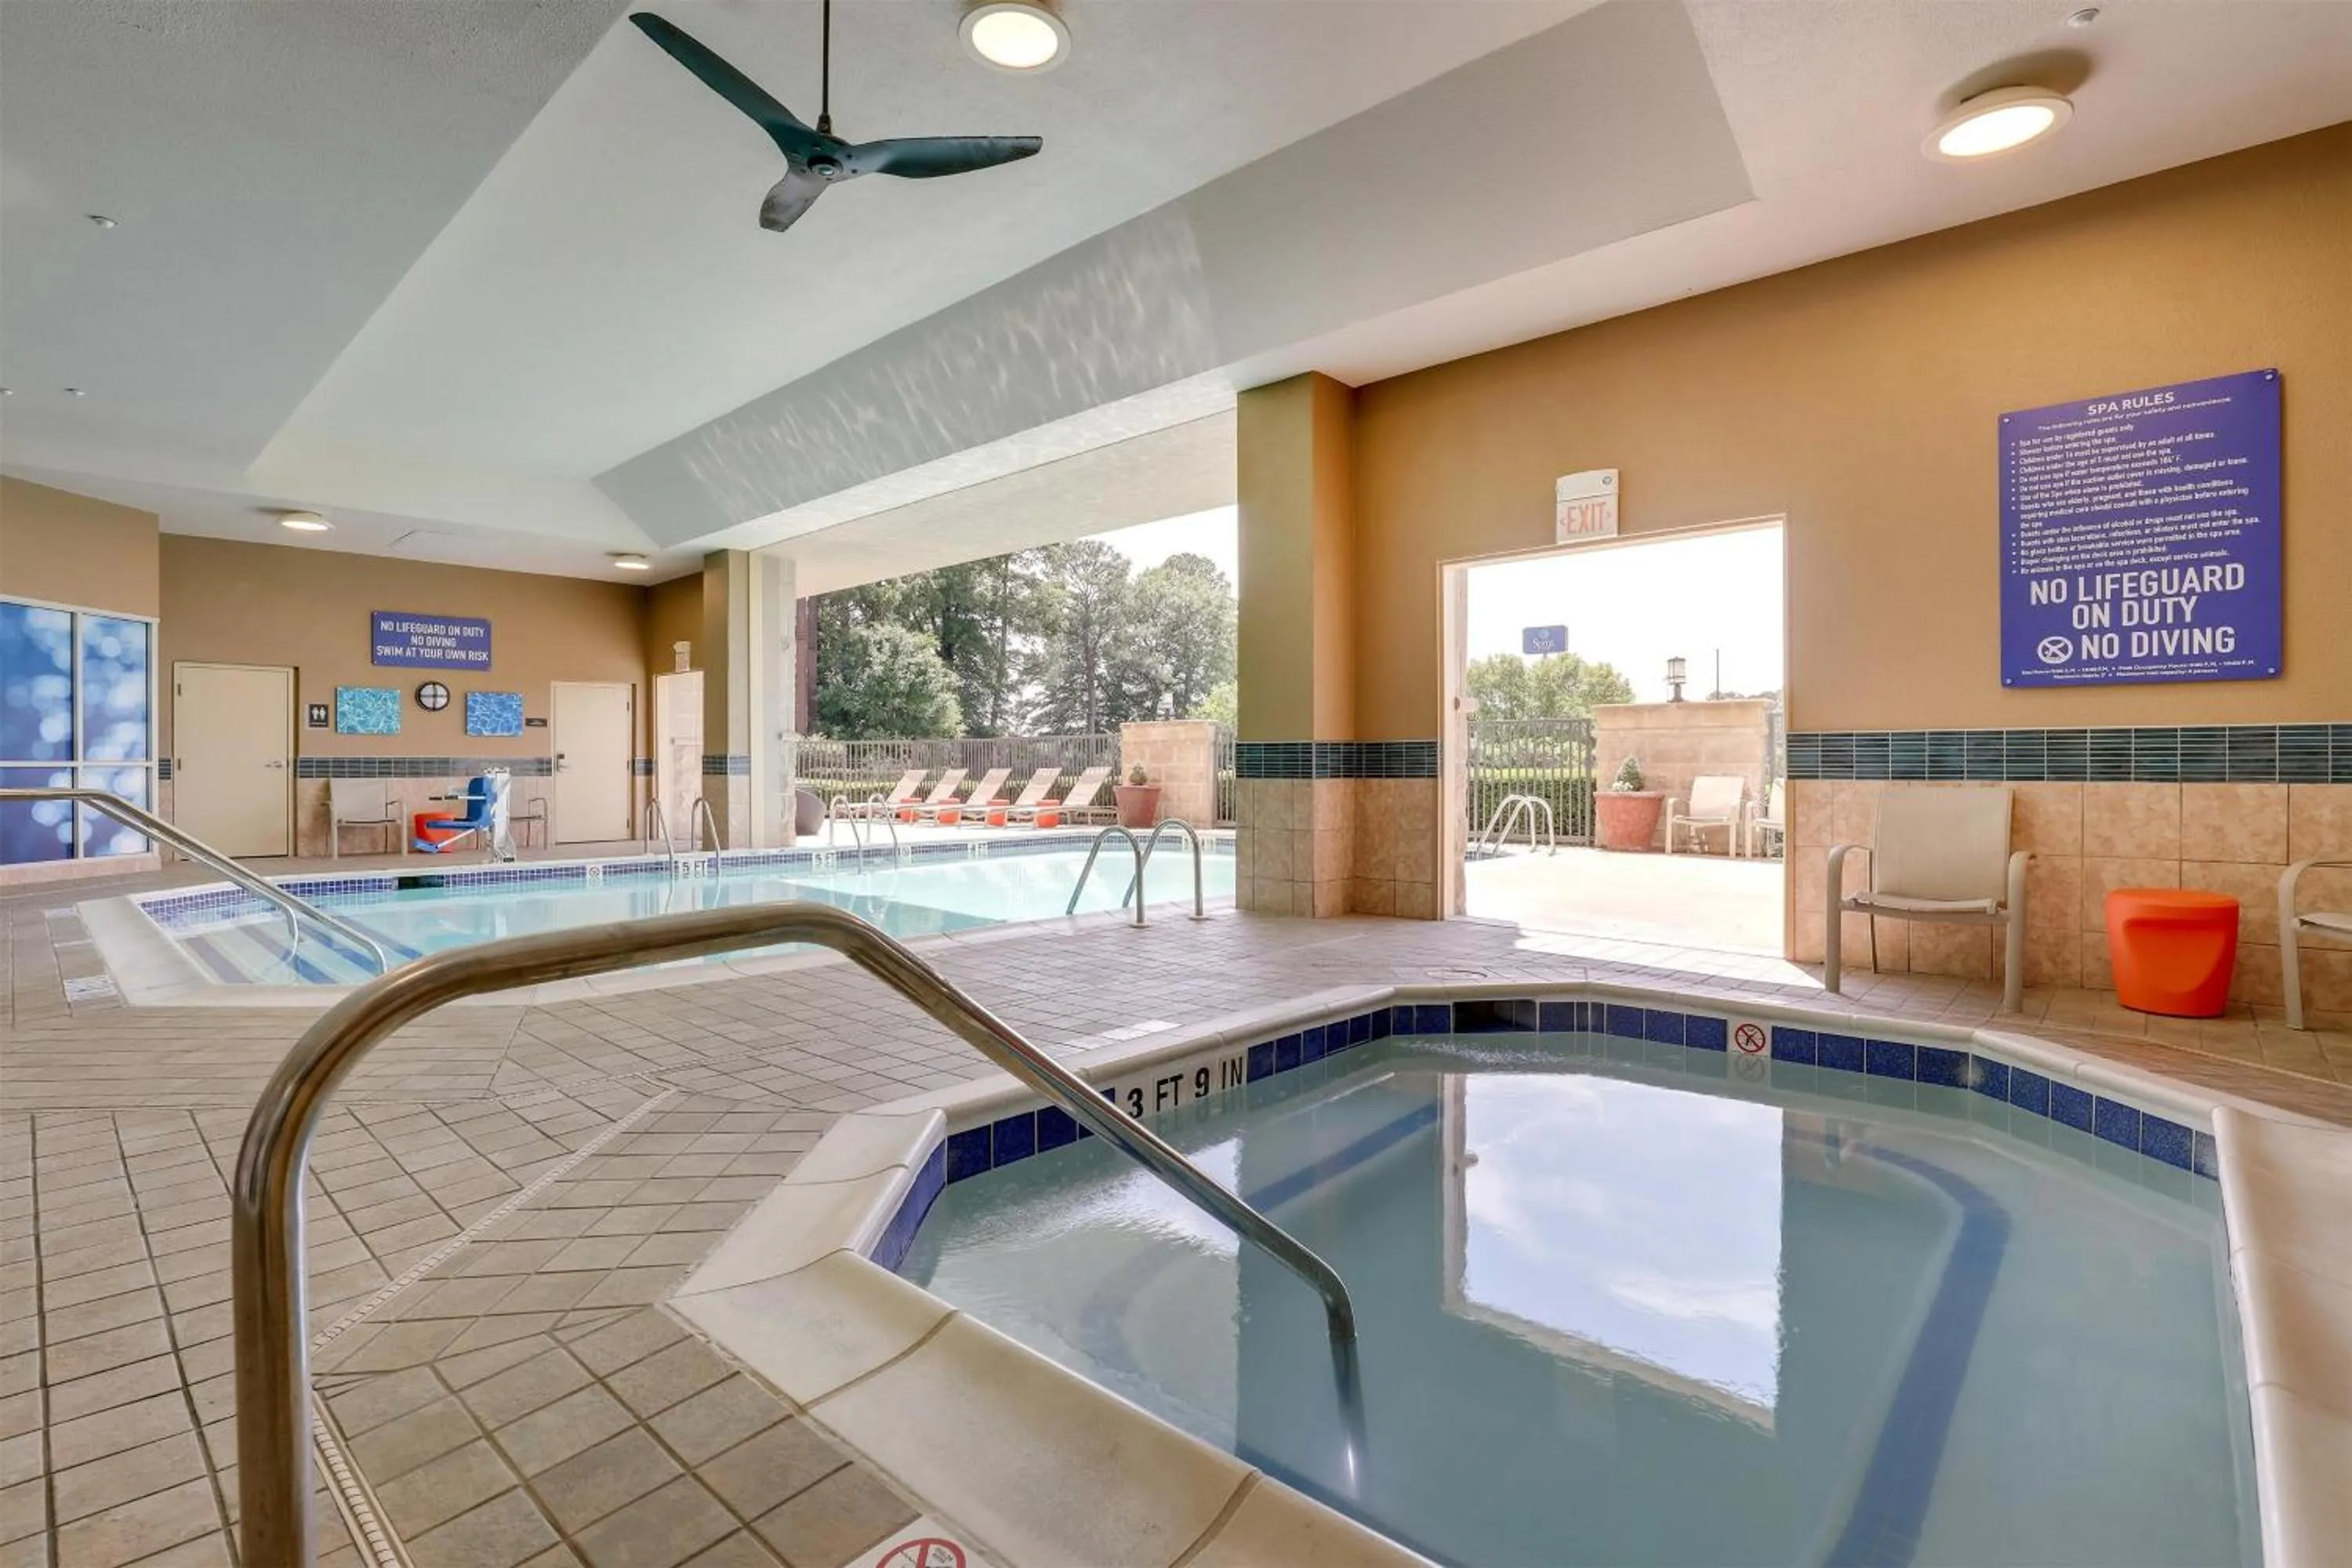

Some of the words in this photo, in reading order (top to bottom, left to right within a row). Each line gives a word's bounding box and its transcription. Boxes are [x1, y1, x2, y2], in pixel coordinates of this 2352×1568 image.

[2088, 401, 2119, 416] SPA
[2122, 392, 2174, 410] RULES
[1567, 502, 1606, 534] EXIT
[2030, 578, 2067, 605] NO
[2078, 562, 2245, 601] LIFEGUARD
[2072, 602, 2110, 630] ON
[2121, 596, 2197, 626] DUTY
[380, 621, 394, 631] NO
[396, 622, 445, 635] LIFEGUARD
[448, 626, 460, 636] ON
[463, 627, 485, 637] DUTY
[411, 635, 424, 645] NO
[426, 637, 457, 648] DIVING
[2081, 633, 2118, 660] NO
[2131, 626, 2236, 658] DIVING
[376, 646, 403, 656] SWIM
[405, 648, 417, 657] AT
[419, 648, 443, 659] YOUR
[445, 649, 466, 659] OWN
[469, 651, 488, 662] RISK
[694, 860, 706, 871] FT
[1127, 1087, 1144, 1120] 3
[1156, 1073, 1184, 1112] FT
[1195, 1067, 1210, 1098] 9
[1221, 1056, 1243, 1091] IN
